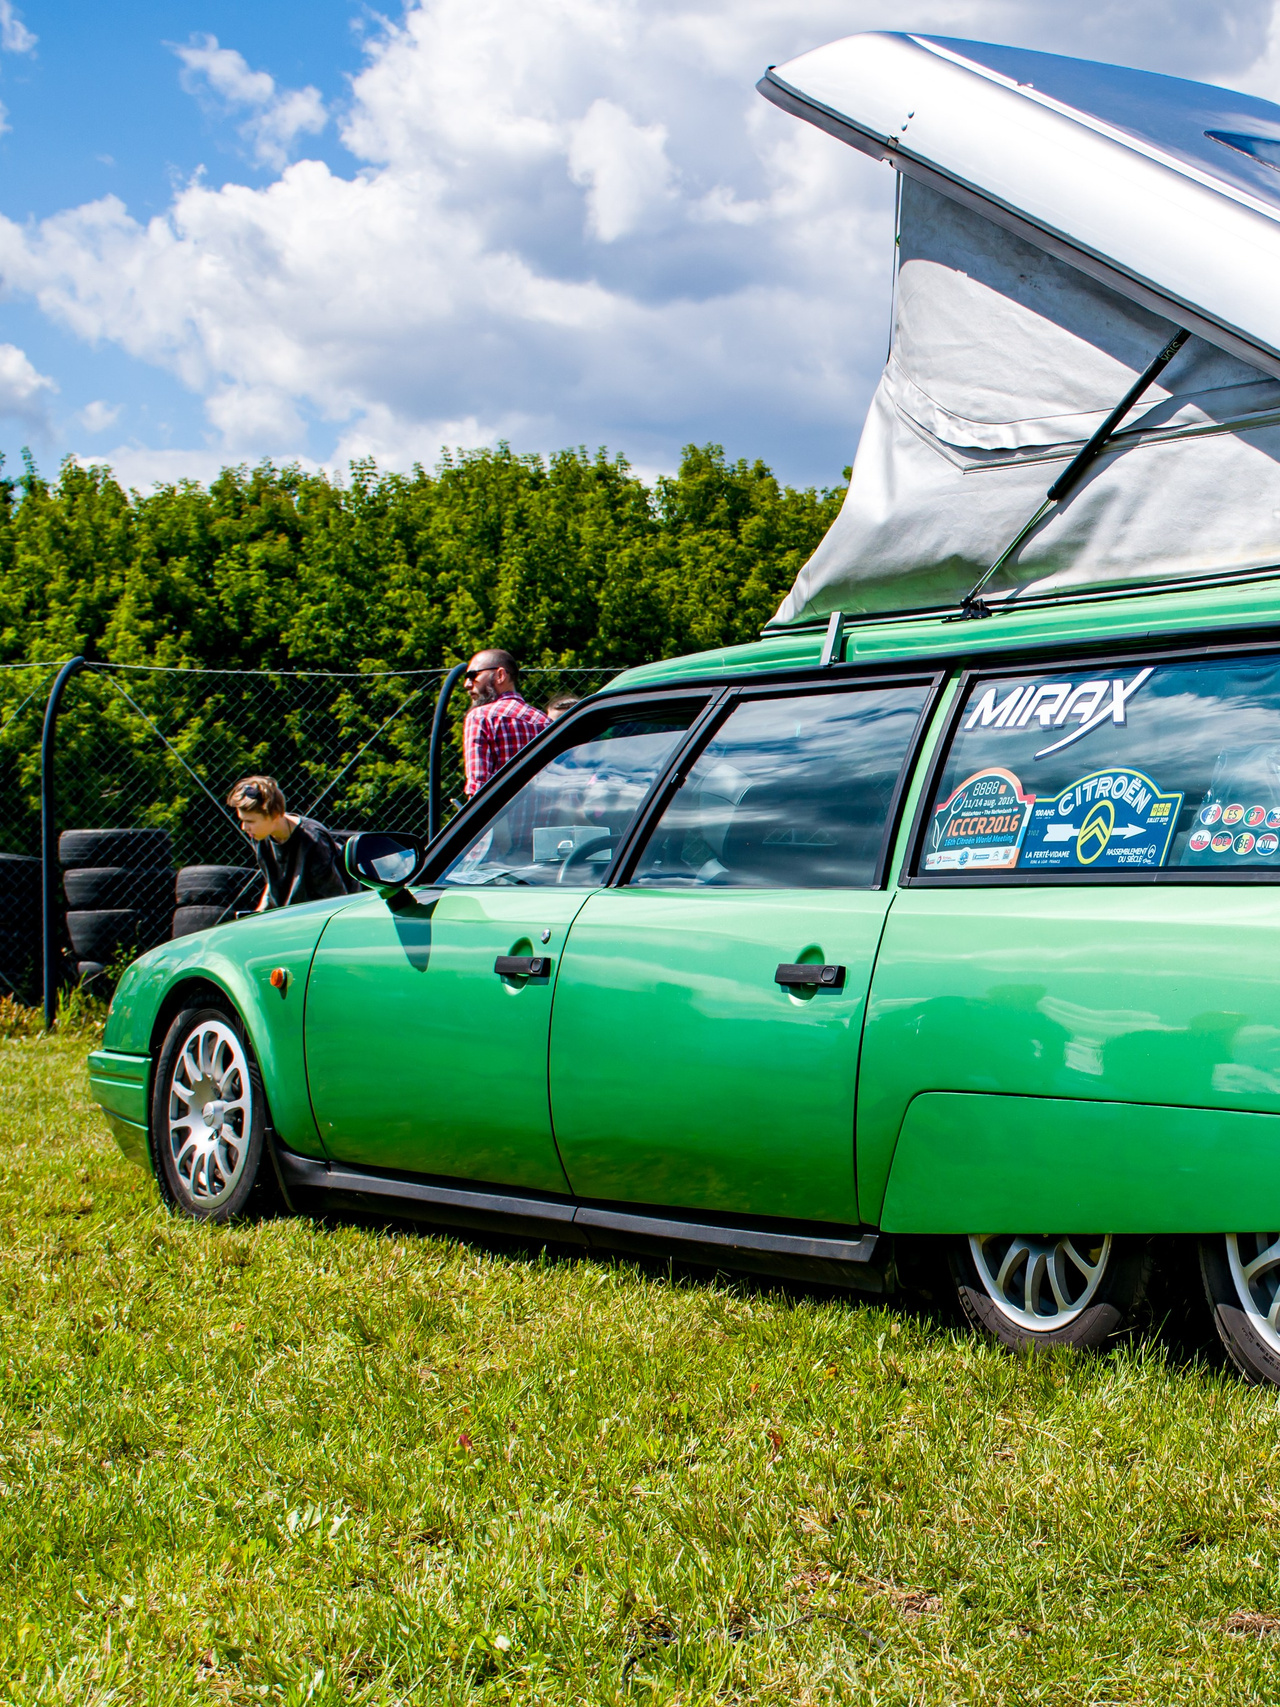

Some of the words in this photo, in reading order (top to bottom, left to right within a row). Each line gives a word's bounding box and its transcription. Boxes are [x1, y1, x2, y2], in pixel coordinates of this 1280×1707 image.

[963, 667, 1158, 761] MIRAX
[1058, 775, 1152, 817] CITROËN
[1206, 810, 1217, 819] FR
[1227, 809, 1238, 819] ES
[1249, 811, 1260, 820] PT
[947, 814, 1020, 837] ICCCR2016
[1195, 835, 1205, 845] PL
[1215, 836, 1228, 846] DE
[1238, 838, 1250, 849] BE
[1261, 839, 1272, 849] NL
